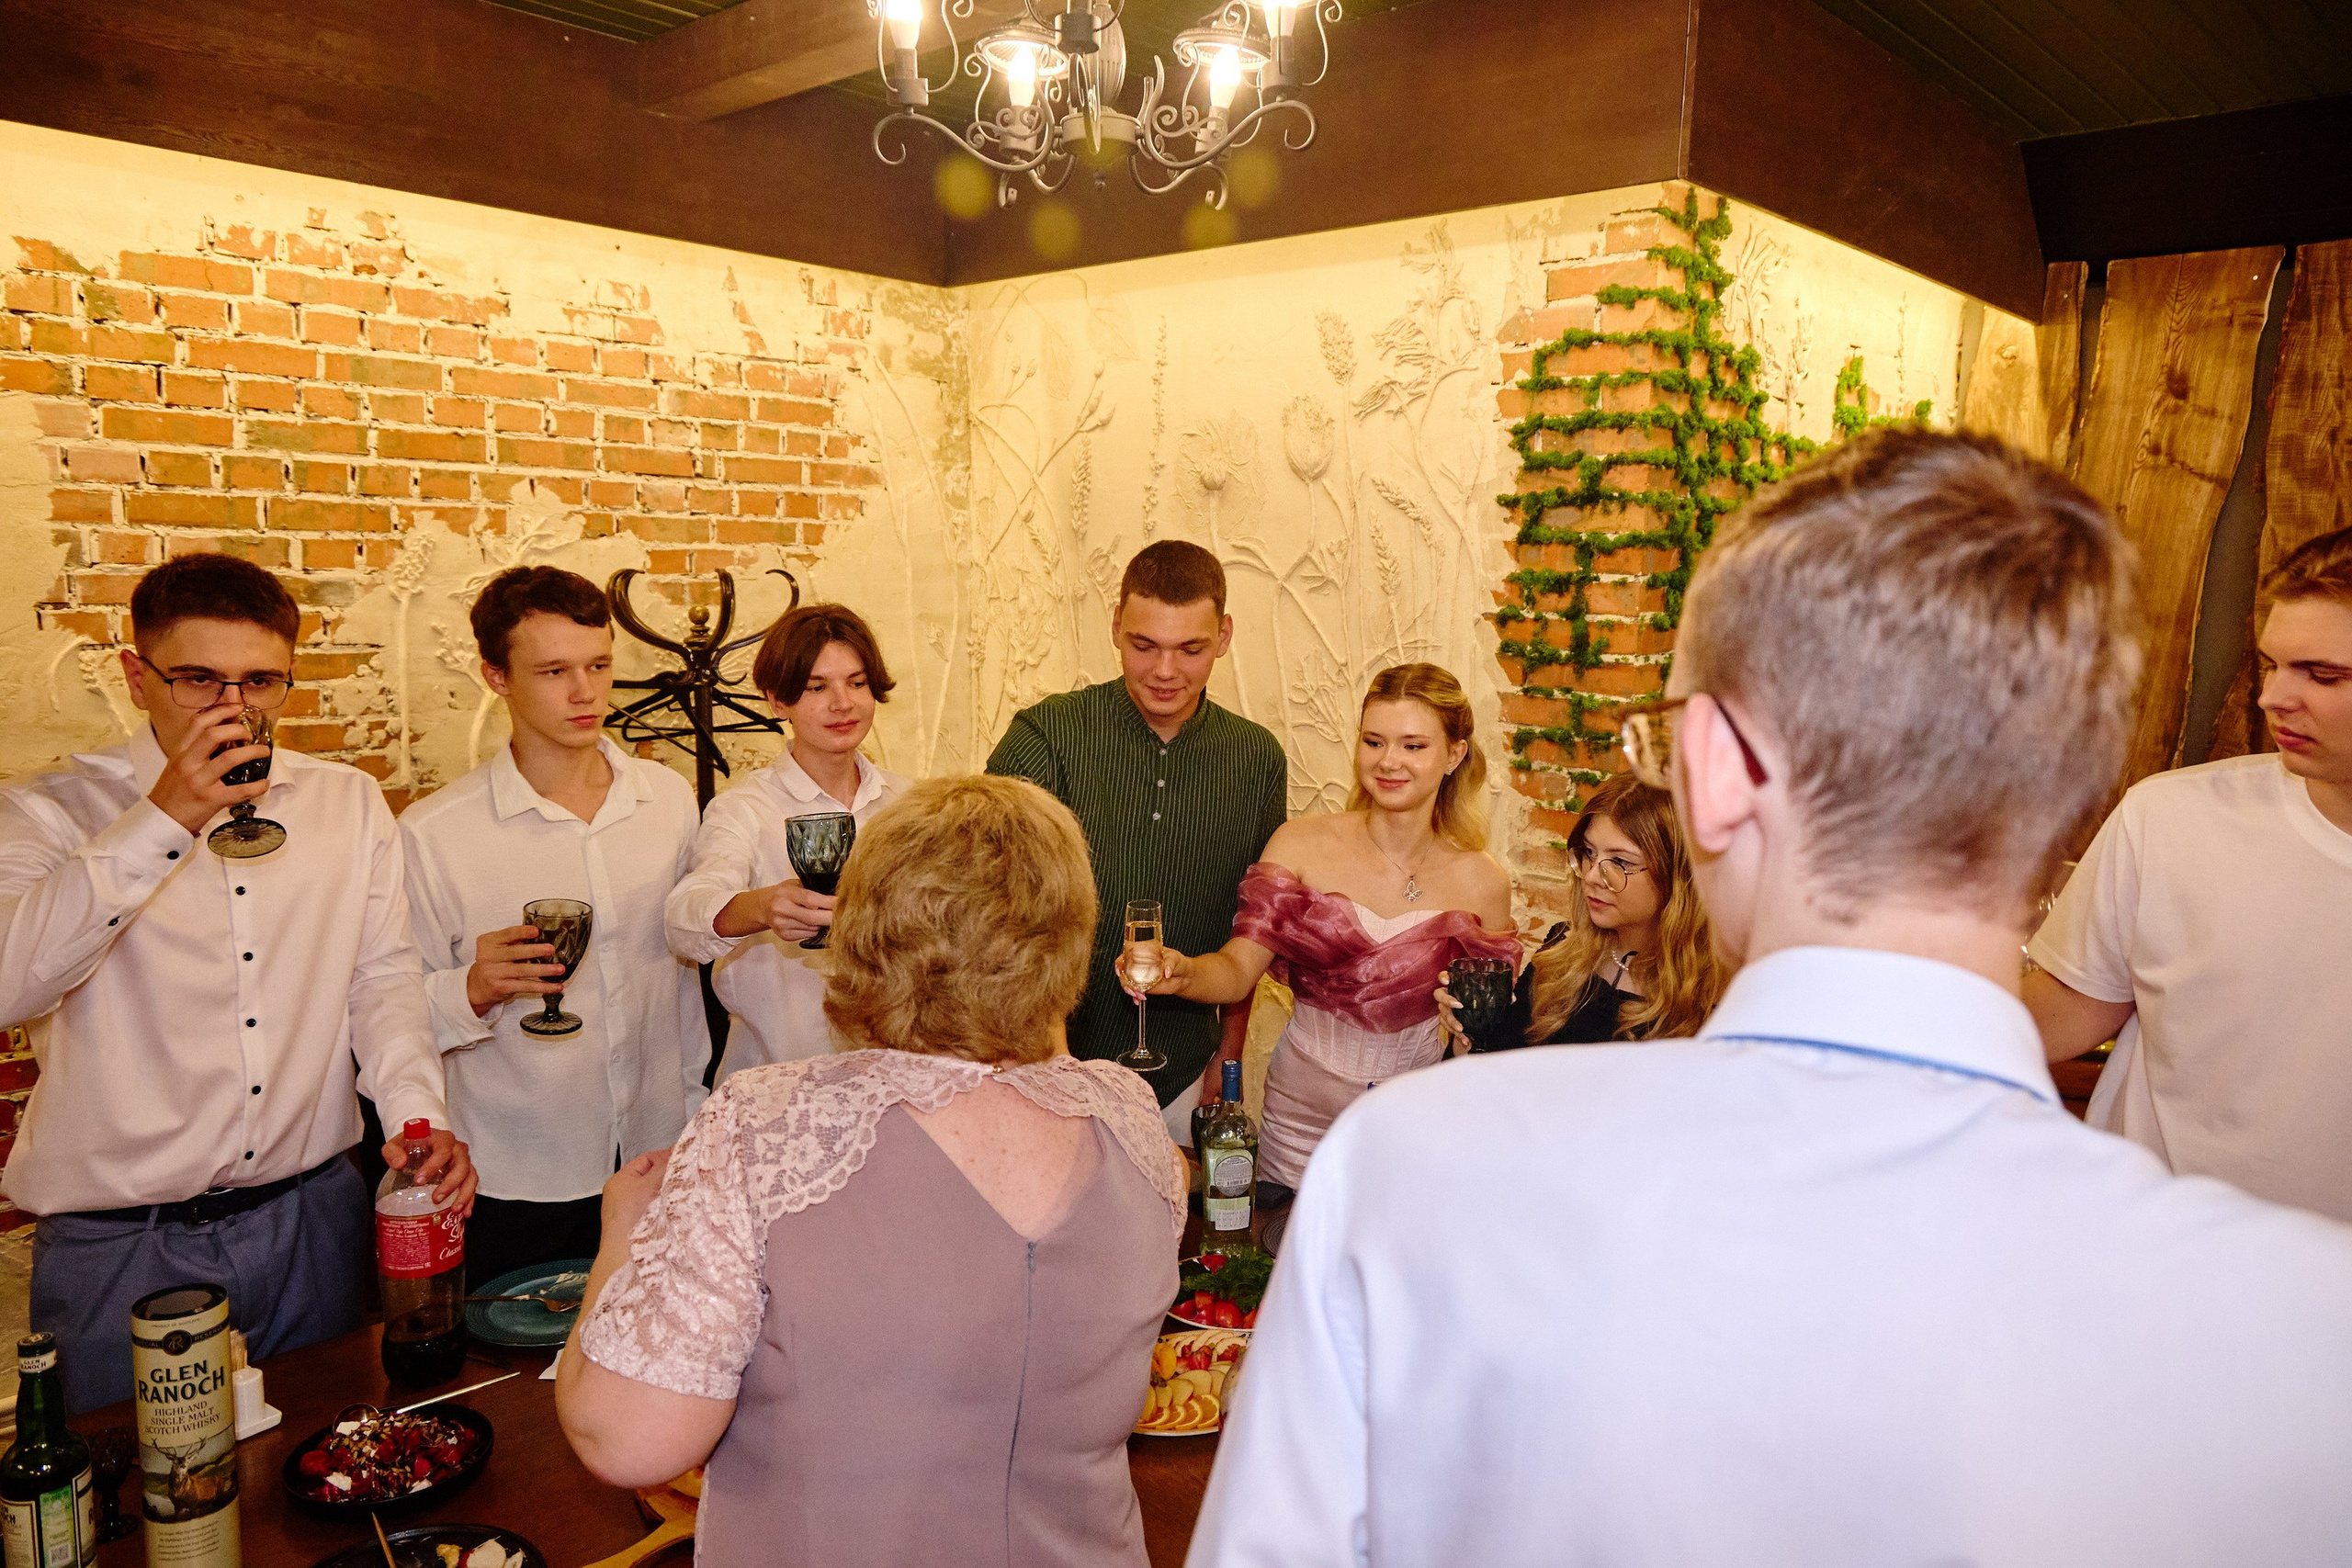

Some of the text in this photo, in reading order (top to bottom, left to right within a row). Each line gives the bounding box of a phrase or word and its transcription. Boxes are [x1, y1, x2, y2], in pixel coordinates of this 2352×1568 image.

[150, 1359, 209, 1383] GLEN
[139, 1366, 226, 1404] RANOCH
[151, 1407, 214, 1426] SINGLE MALT
[154, 1401, 208, 1416] HIGHLAND
[144, 1414, 221, 1435] SCOTCH WHISKY
